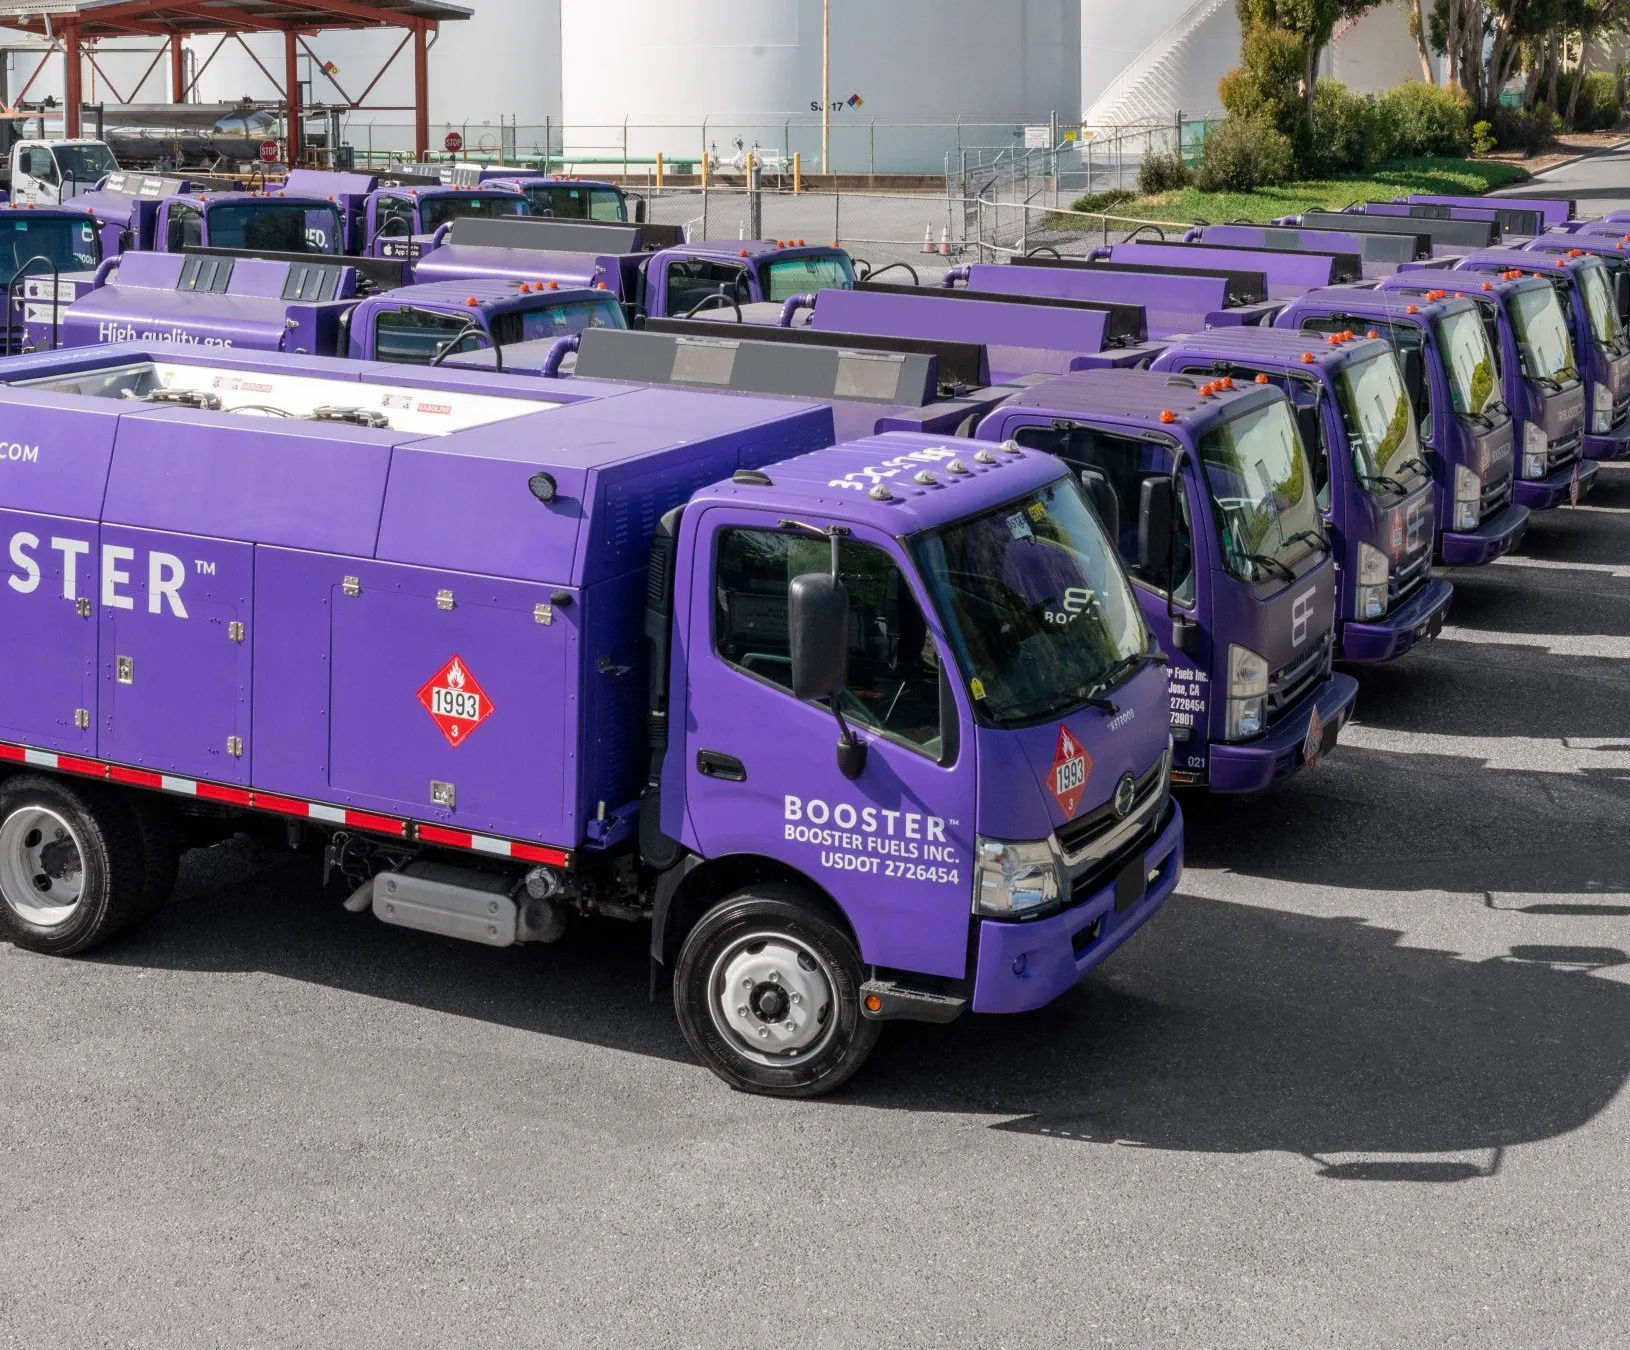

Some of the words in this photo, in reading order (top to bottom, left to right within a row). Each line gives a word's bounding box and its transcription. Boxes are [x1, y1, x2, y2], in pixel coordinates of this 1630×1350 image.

[261, 146, 277, 156] STOP
[99, 321, 137, 343] High
[1174, 667, 1194, 681] Fuels
[1195, 669, 1209, 682] Inc.
[1168, 681, 1188, 697] Jose,
[1189, 683, 1200, 697] CA
[434, 689, 477, 718] 1993
[1170, 697, 1205, 713] 2726454
[451, 724, 459, 737] 3
[1187, 756, 1206, 769] 021
[1057, 759, 1084, 792] 1993
[1068, 798, 1074, 811] 3
[784, 824, 863, 850] BOOSTER
[867, 837, 919, 858] FUELS
[923, 844, 960, 864] INC.
[821, 851, 881, 874] USDOT
[884, 860, 960, 885] 2726454
